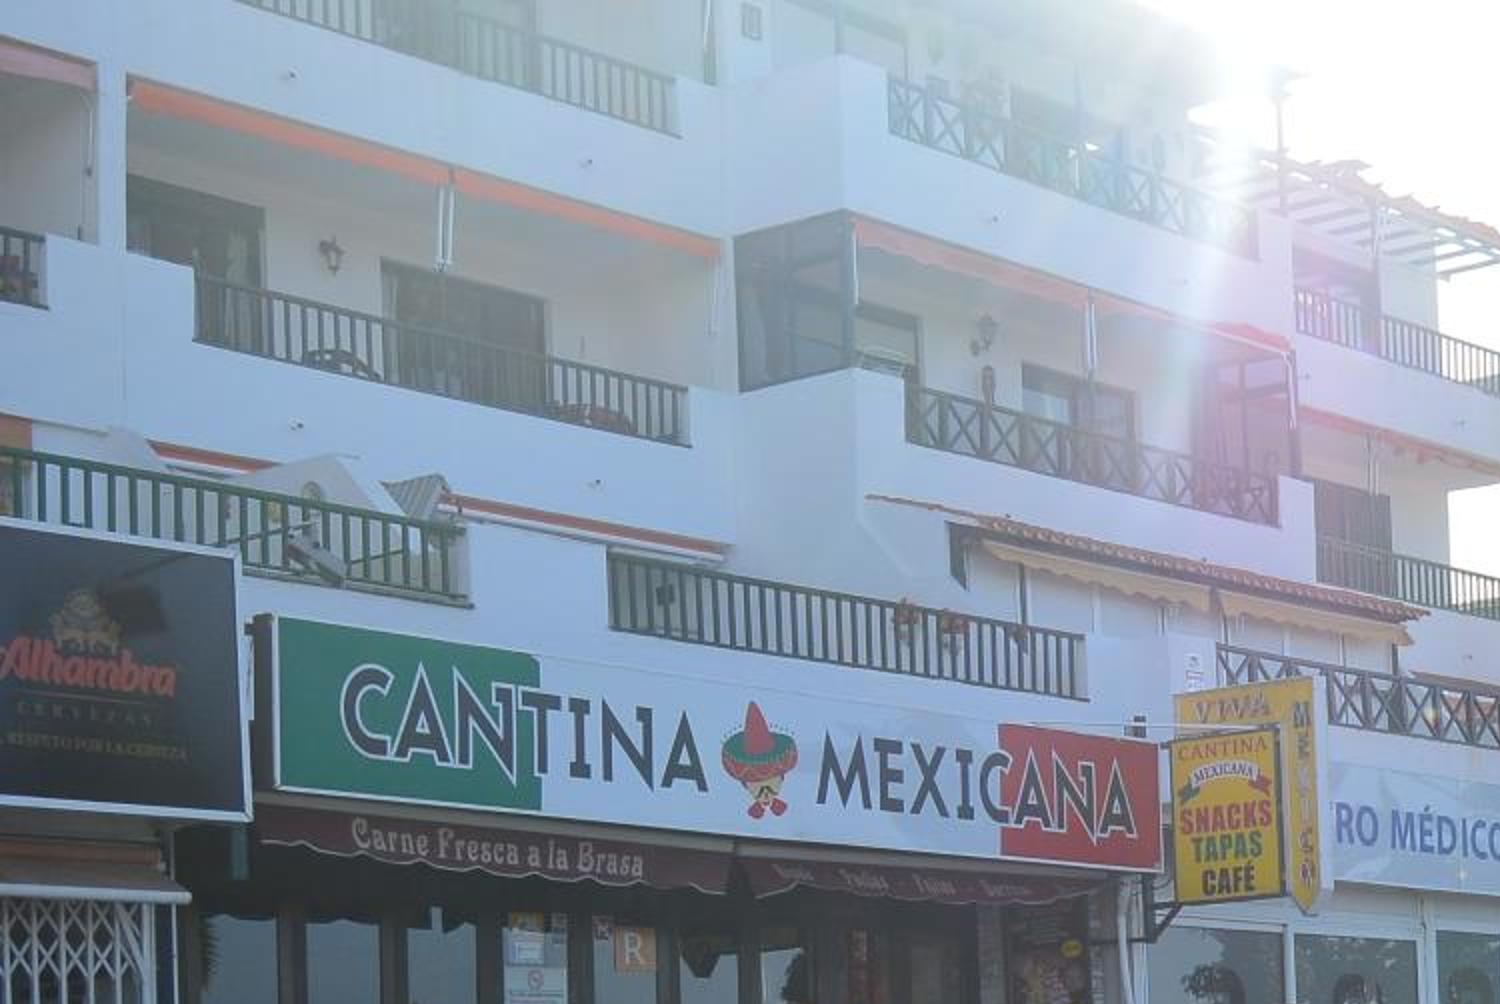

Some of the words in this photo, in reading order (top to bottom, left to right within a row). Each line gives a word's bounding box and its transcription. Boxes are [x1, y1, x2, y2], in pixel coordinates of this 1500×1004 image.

[0, 636, 177, 698] Alhambra
[1192, 690, 1271, 723] VIVA
[340, 661, 708, 792] CANTINA
[816, 730, 1138, 846] MEXICANA
[1177, 736, 1268, 761] CANTINA
[1194, 763, 1255, 783] MEXICANA
[1179, 800, 1272, 834] SNACKS
[1332, 803, 1379, 848] RO
[350, 818, 429, 856] Carne
[439, 827, 519, 866] Fresca
[526, 845, 541, 868] a
[548, 840, 569, 870] la
[578, 842, 644, 879] Brasa
[1191, 832, 1263, 862] TAPAS
[1202, 860, 1256, 896] CAFÉ
[624, 932, 643, 965] R
